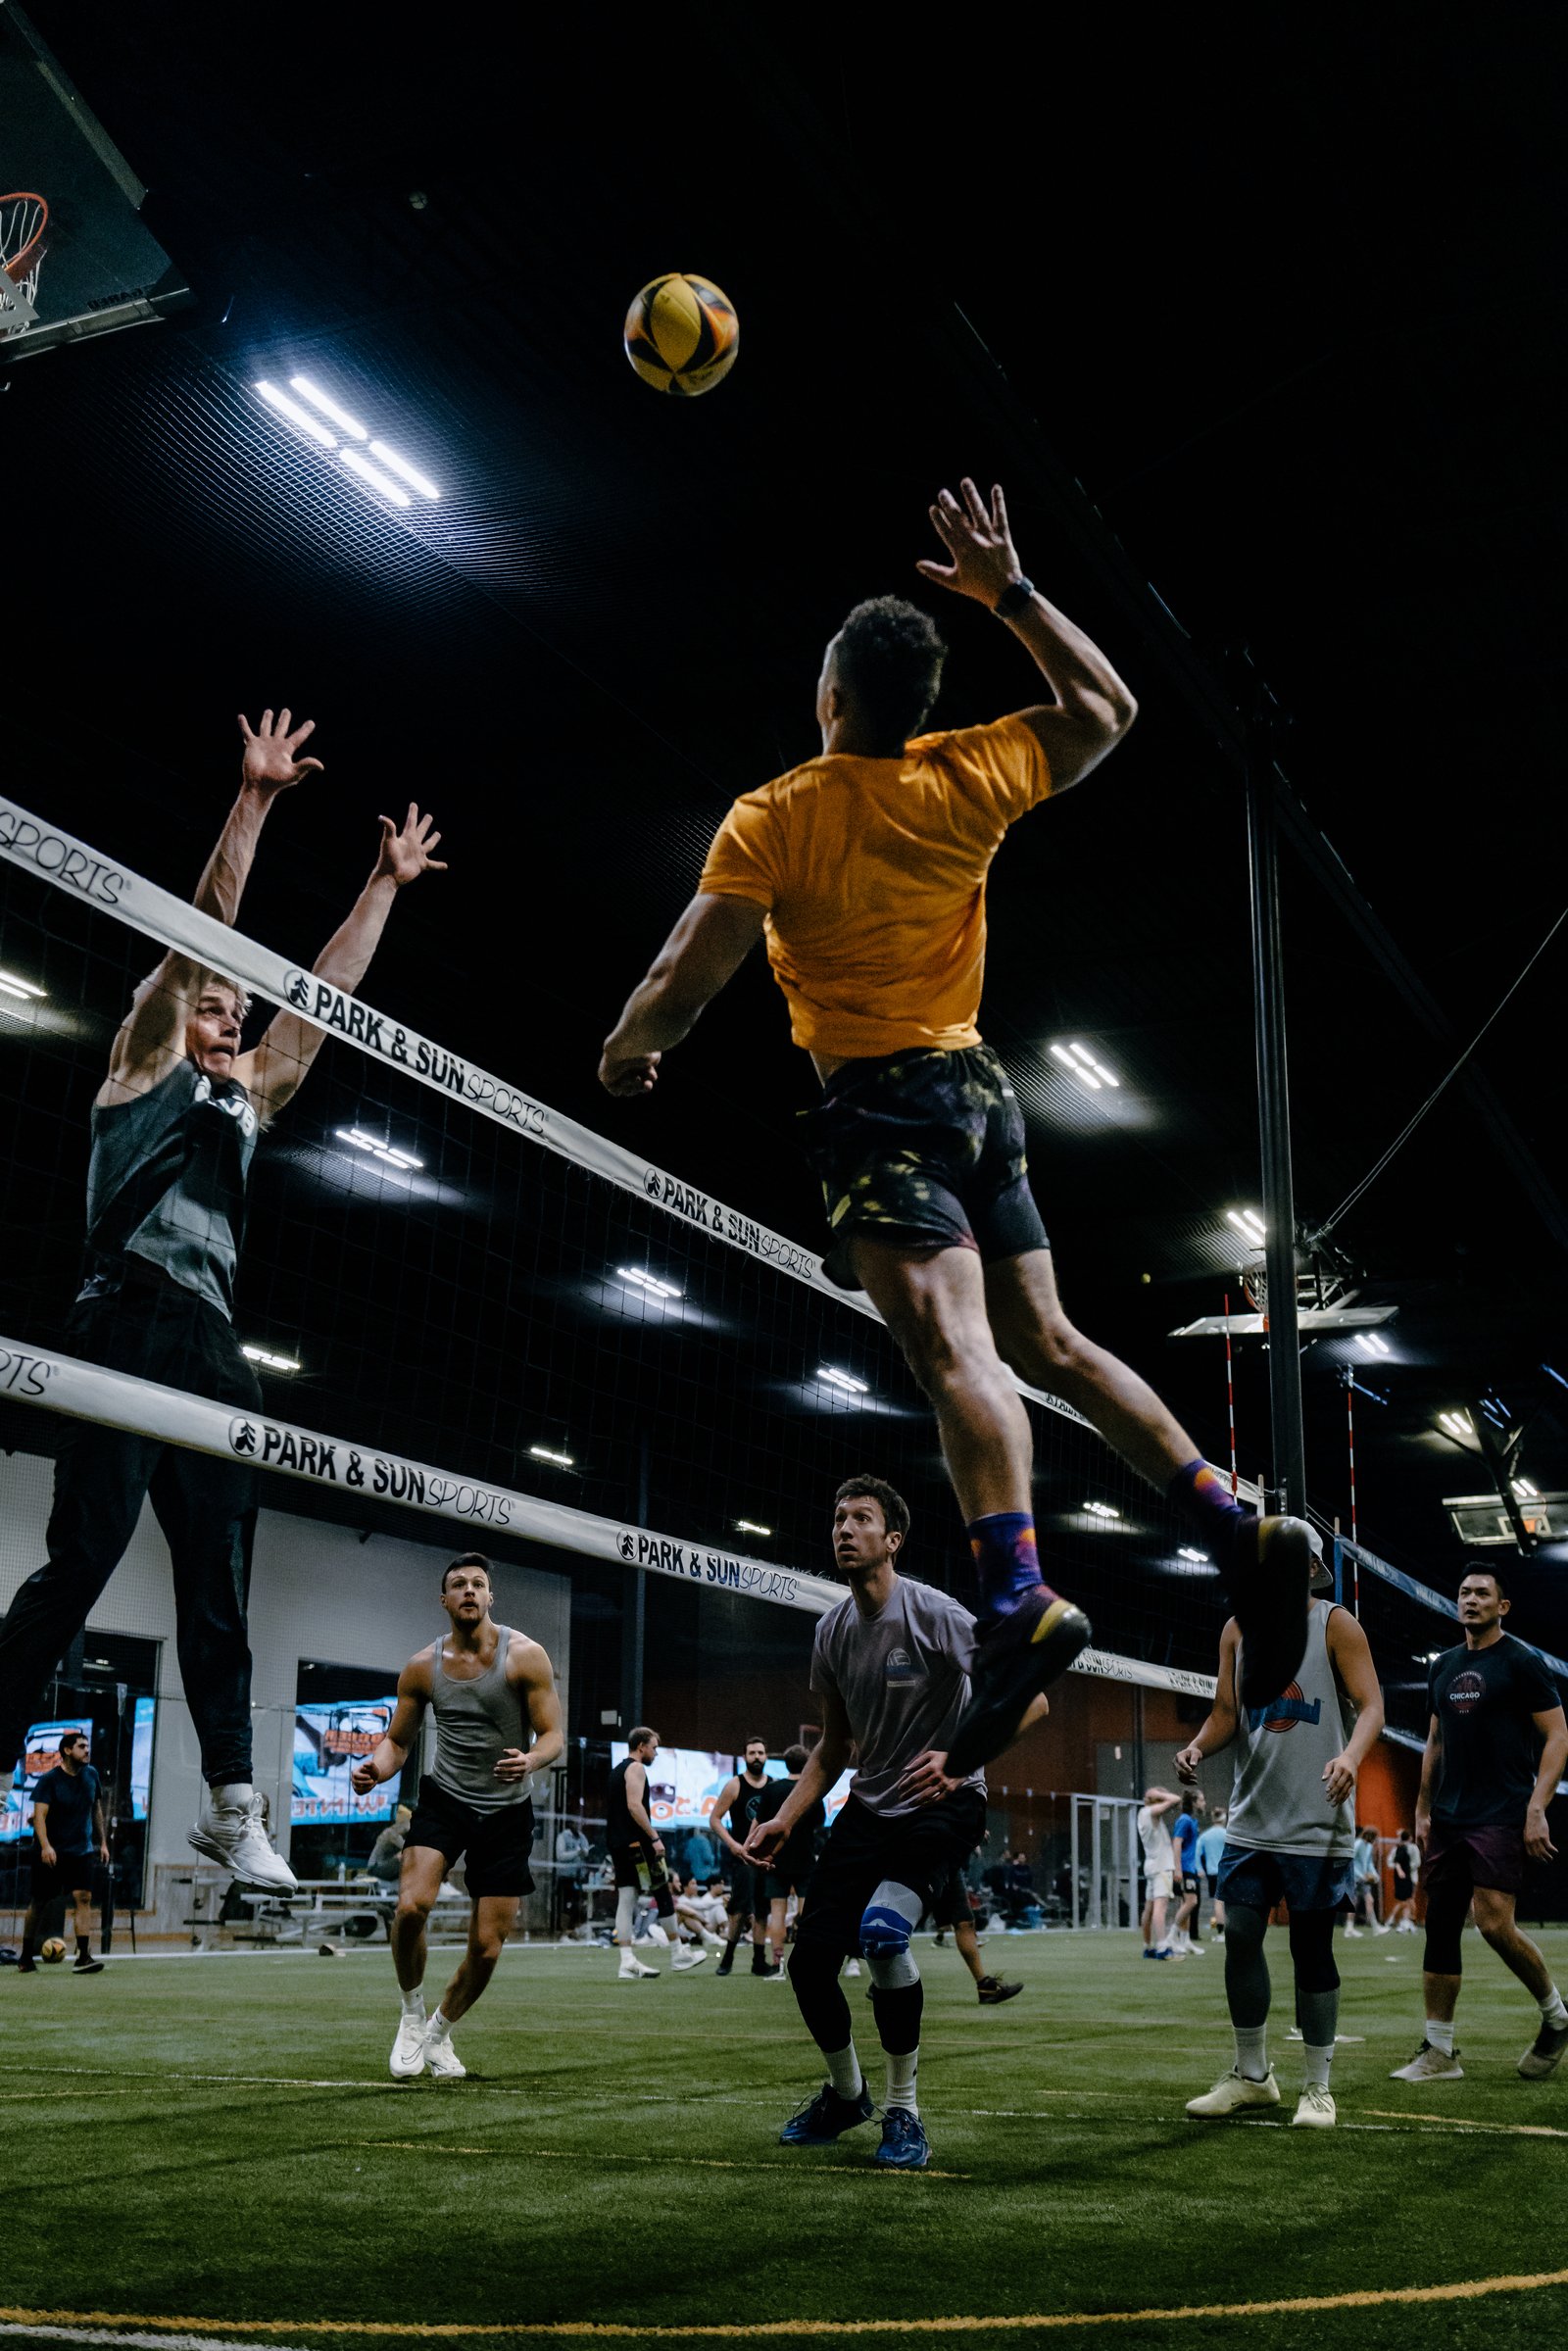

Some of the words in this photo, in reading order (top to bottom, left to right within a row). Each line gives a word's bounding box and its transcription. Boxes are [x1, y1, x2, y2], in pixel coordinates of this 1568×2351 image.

[315, 983, 385, 1052] PARK
[391, 1028, 408, 1064] &
[662, 1177, 708, 1224] PARK
[712, 1204, 724, 1234] &
[262, 1425, 336, 1480] PARK
[346, 1450, 365, 1488] &
[638, 1534, 684, 1574] PARK
[690, 1548, 702, 1578] &
[1449, 1691, 1481, 1700] CHICAGO
